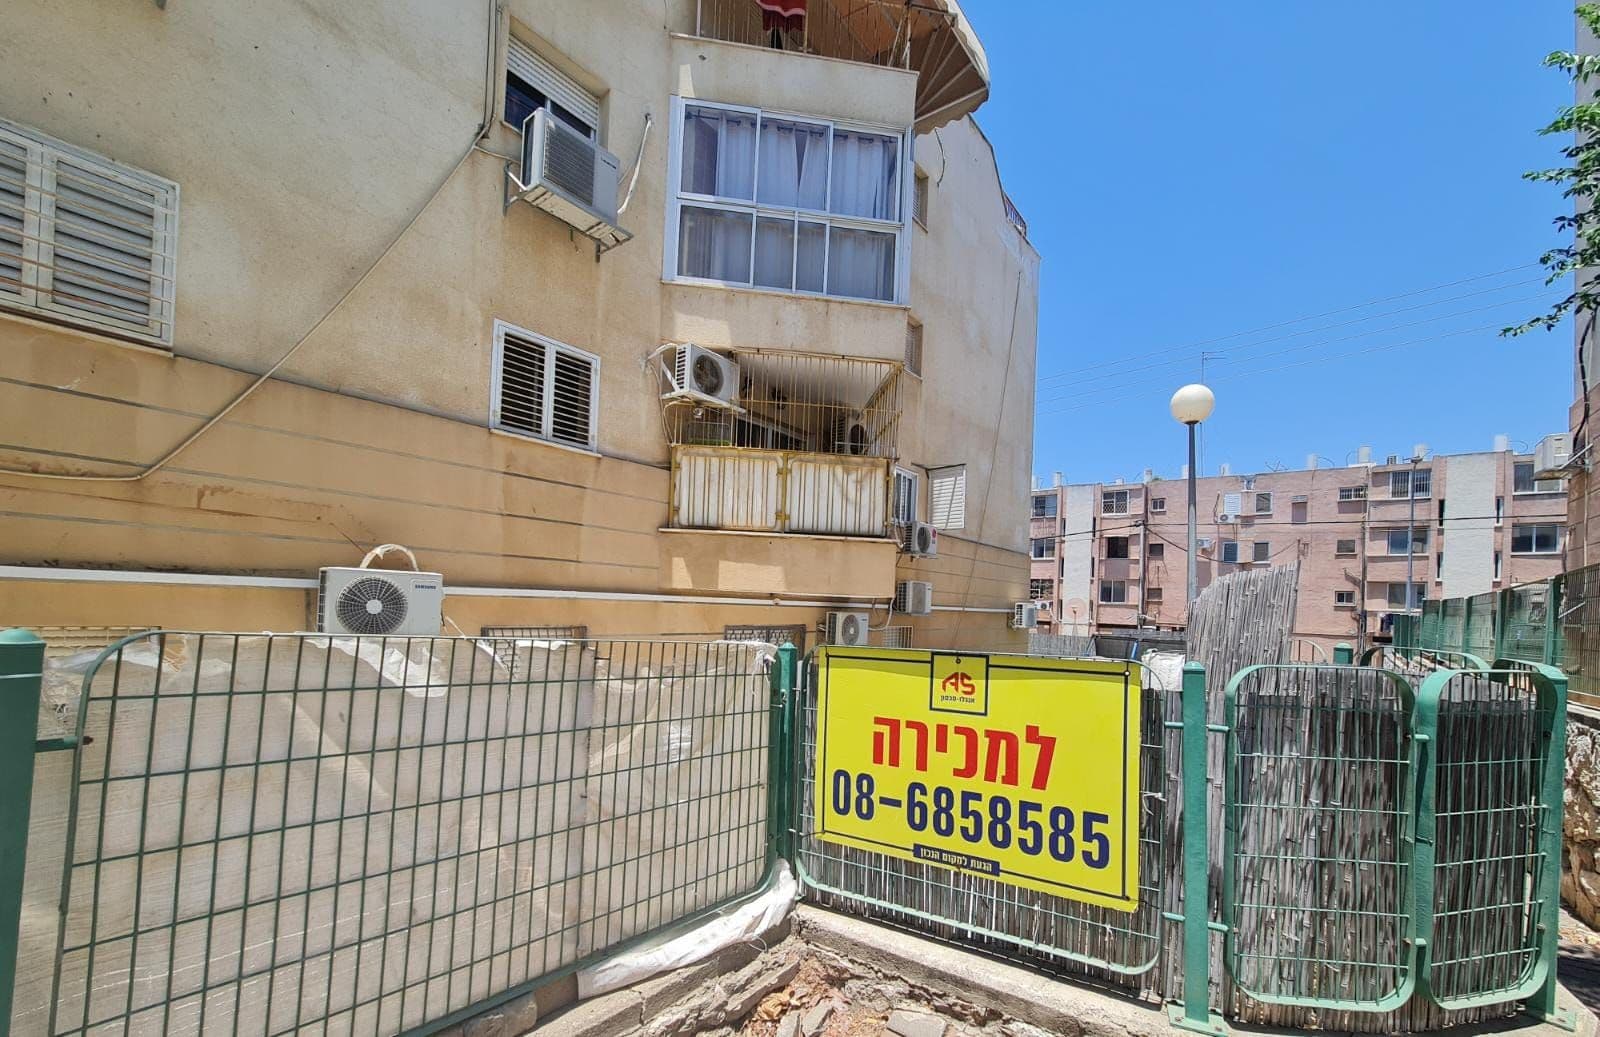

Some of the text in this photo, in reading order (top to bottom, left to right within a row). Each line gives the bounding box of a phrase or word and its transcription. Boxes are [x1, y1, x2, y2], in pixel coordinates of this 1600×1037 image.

[873, 717, 1057, 790] למכירה
[832, 769, 1110, 870] 08-6858585
[920, 847, 940, 861] הנכון
[942, 852, 968, 866] למקום
